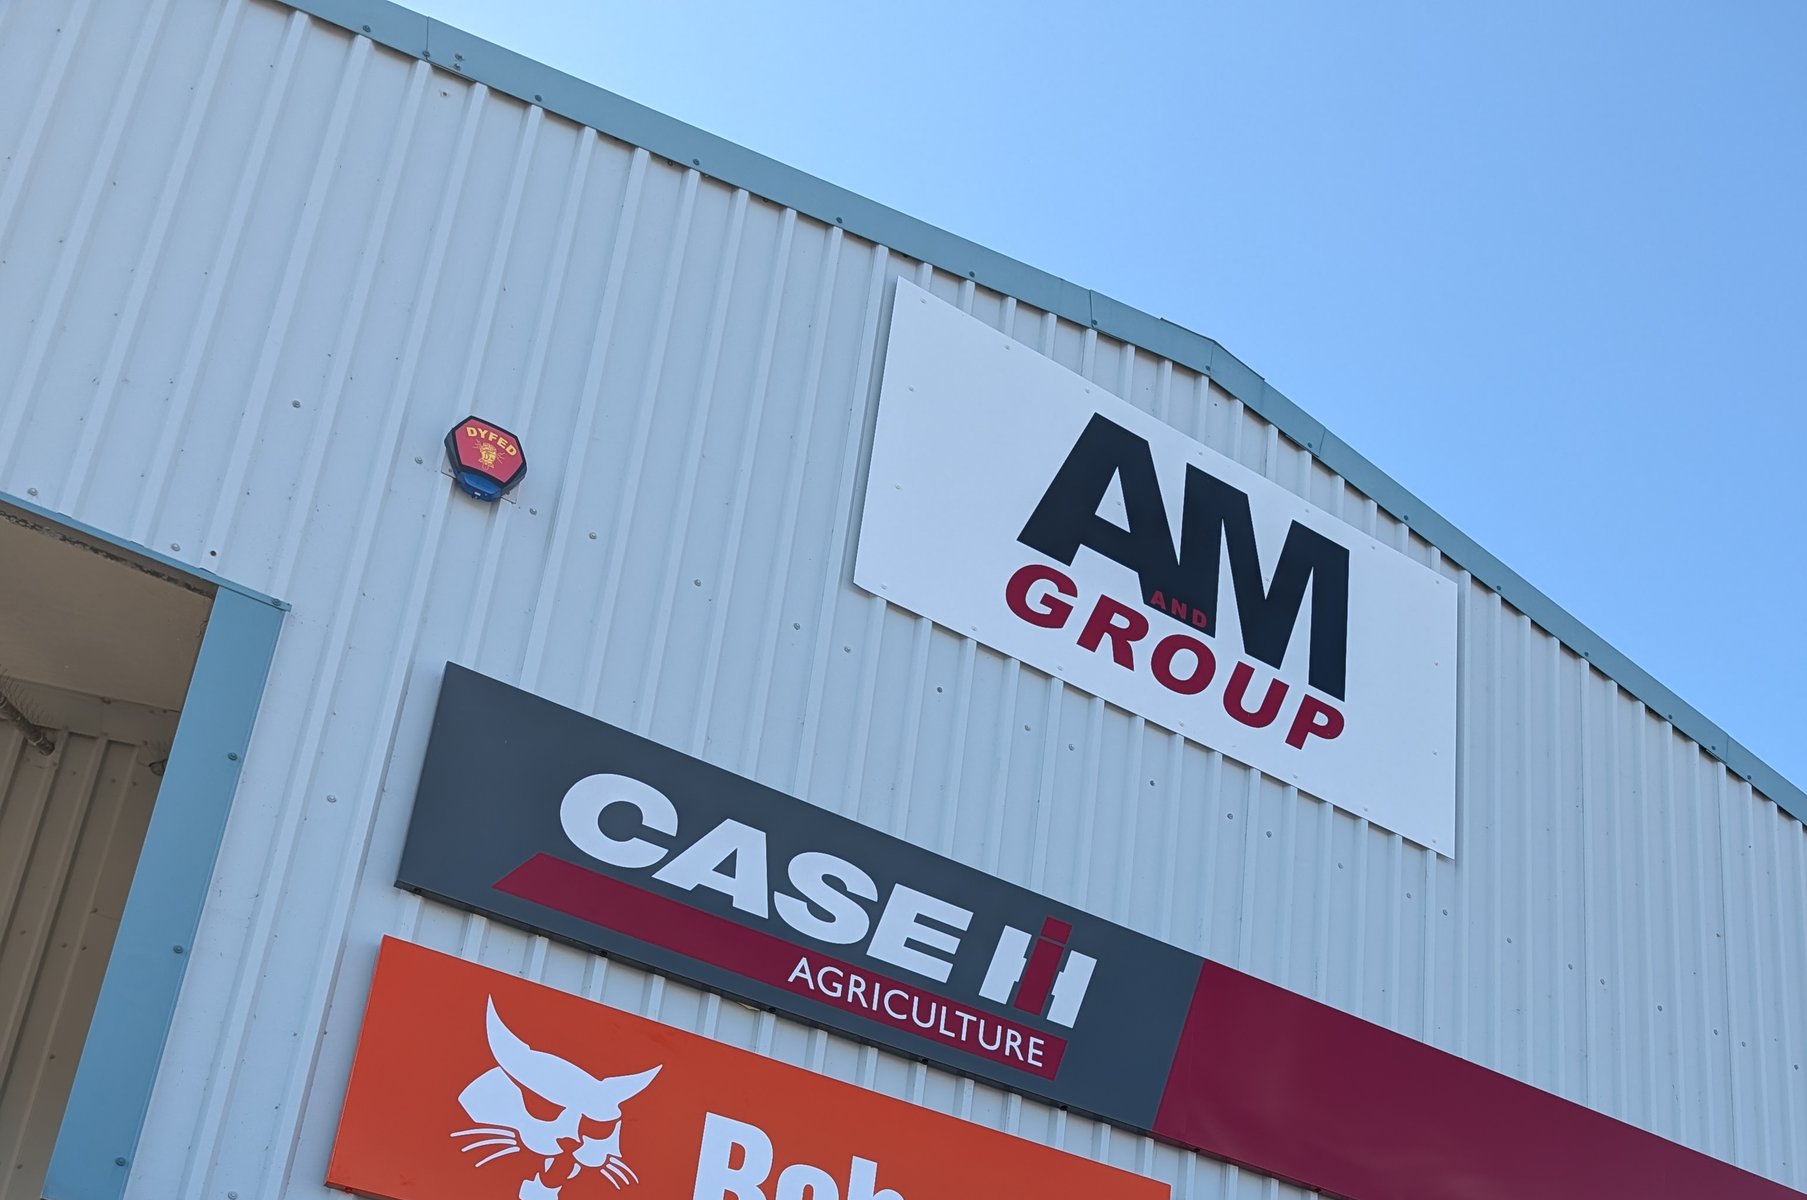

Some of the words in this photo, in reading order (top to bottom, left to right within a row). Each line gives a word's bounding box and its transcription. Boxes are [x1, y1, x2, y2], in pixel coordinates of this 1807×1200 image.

[466, 426, 517, 456] DYFED
[1005, 563, 1346, 751] GROUP
[1150, 590, 1208, 629] AND
[560, 773, 974, 984] CASE
[788, 956, 1046, 1068] AGRICULTURE
